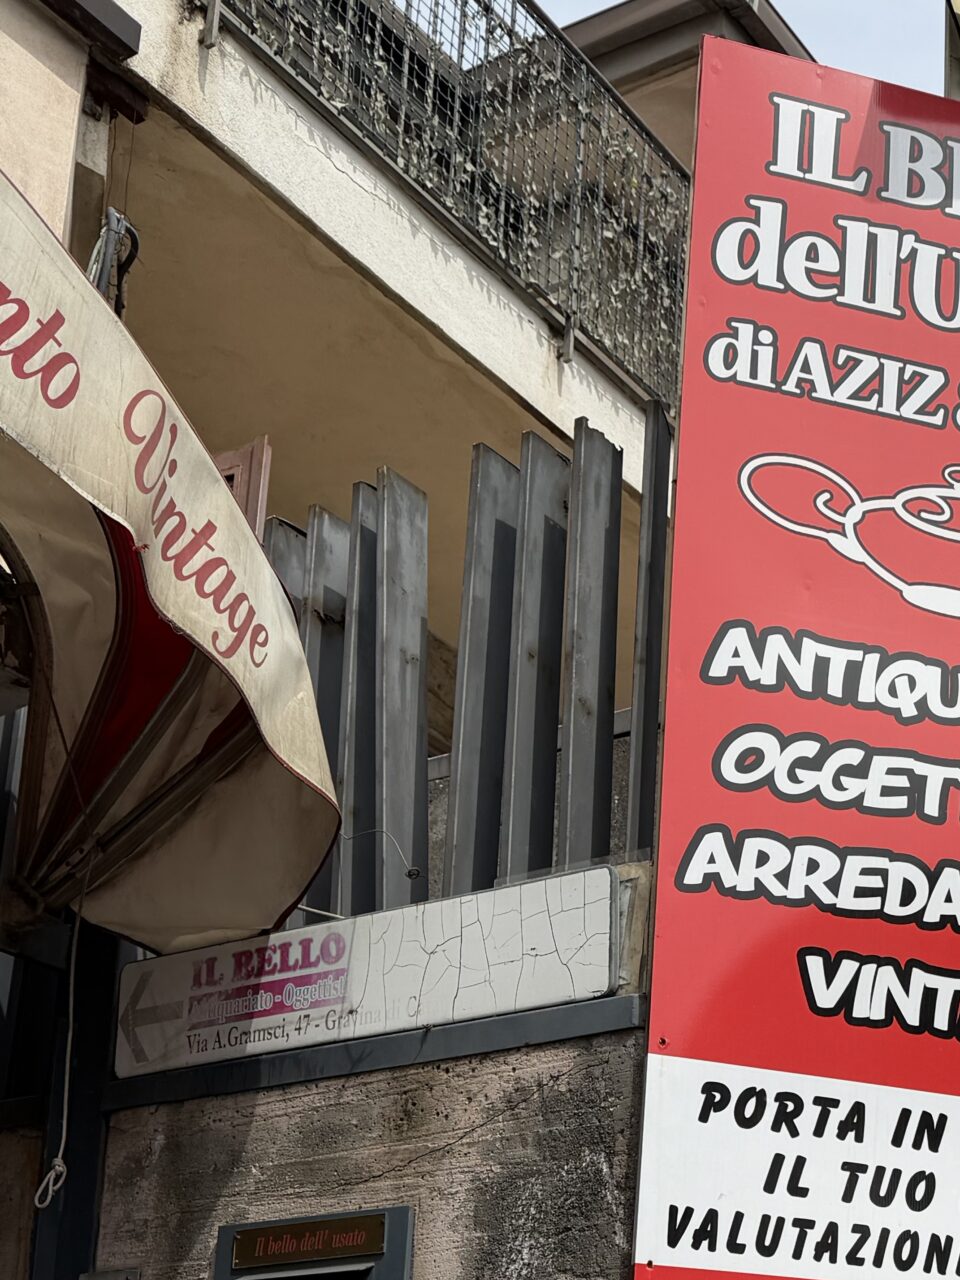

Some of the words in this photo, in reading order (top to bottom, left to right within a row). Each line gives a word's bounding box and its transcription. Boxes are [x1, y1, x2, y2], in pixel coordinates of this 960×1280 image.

[766, 94, 870, 195] IL
[706, 320, 777, 391] di
[780, 338, 947, 428] AZIZ
[122, 389, 270, 669] Vintage
[186, 1033, 208, 1055] Via
[294, 1013, 312, 1036] 47
[696, 1080, 867, 1145] PORTA
[890, 1107, 948, 1153] IN
[762, 1152, 811, 1199] IL
[840, 1161, 937, 1213] TUO
[267, 1234, 297, 1256] bello
[331, 1229, 366, 1249] usato
